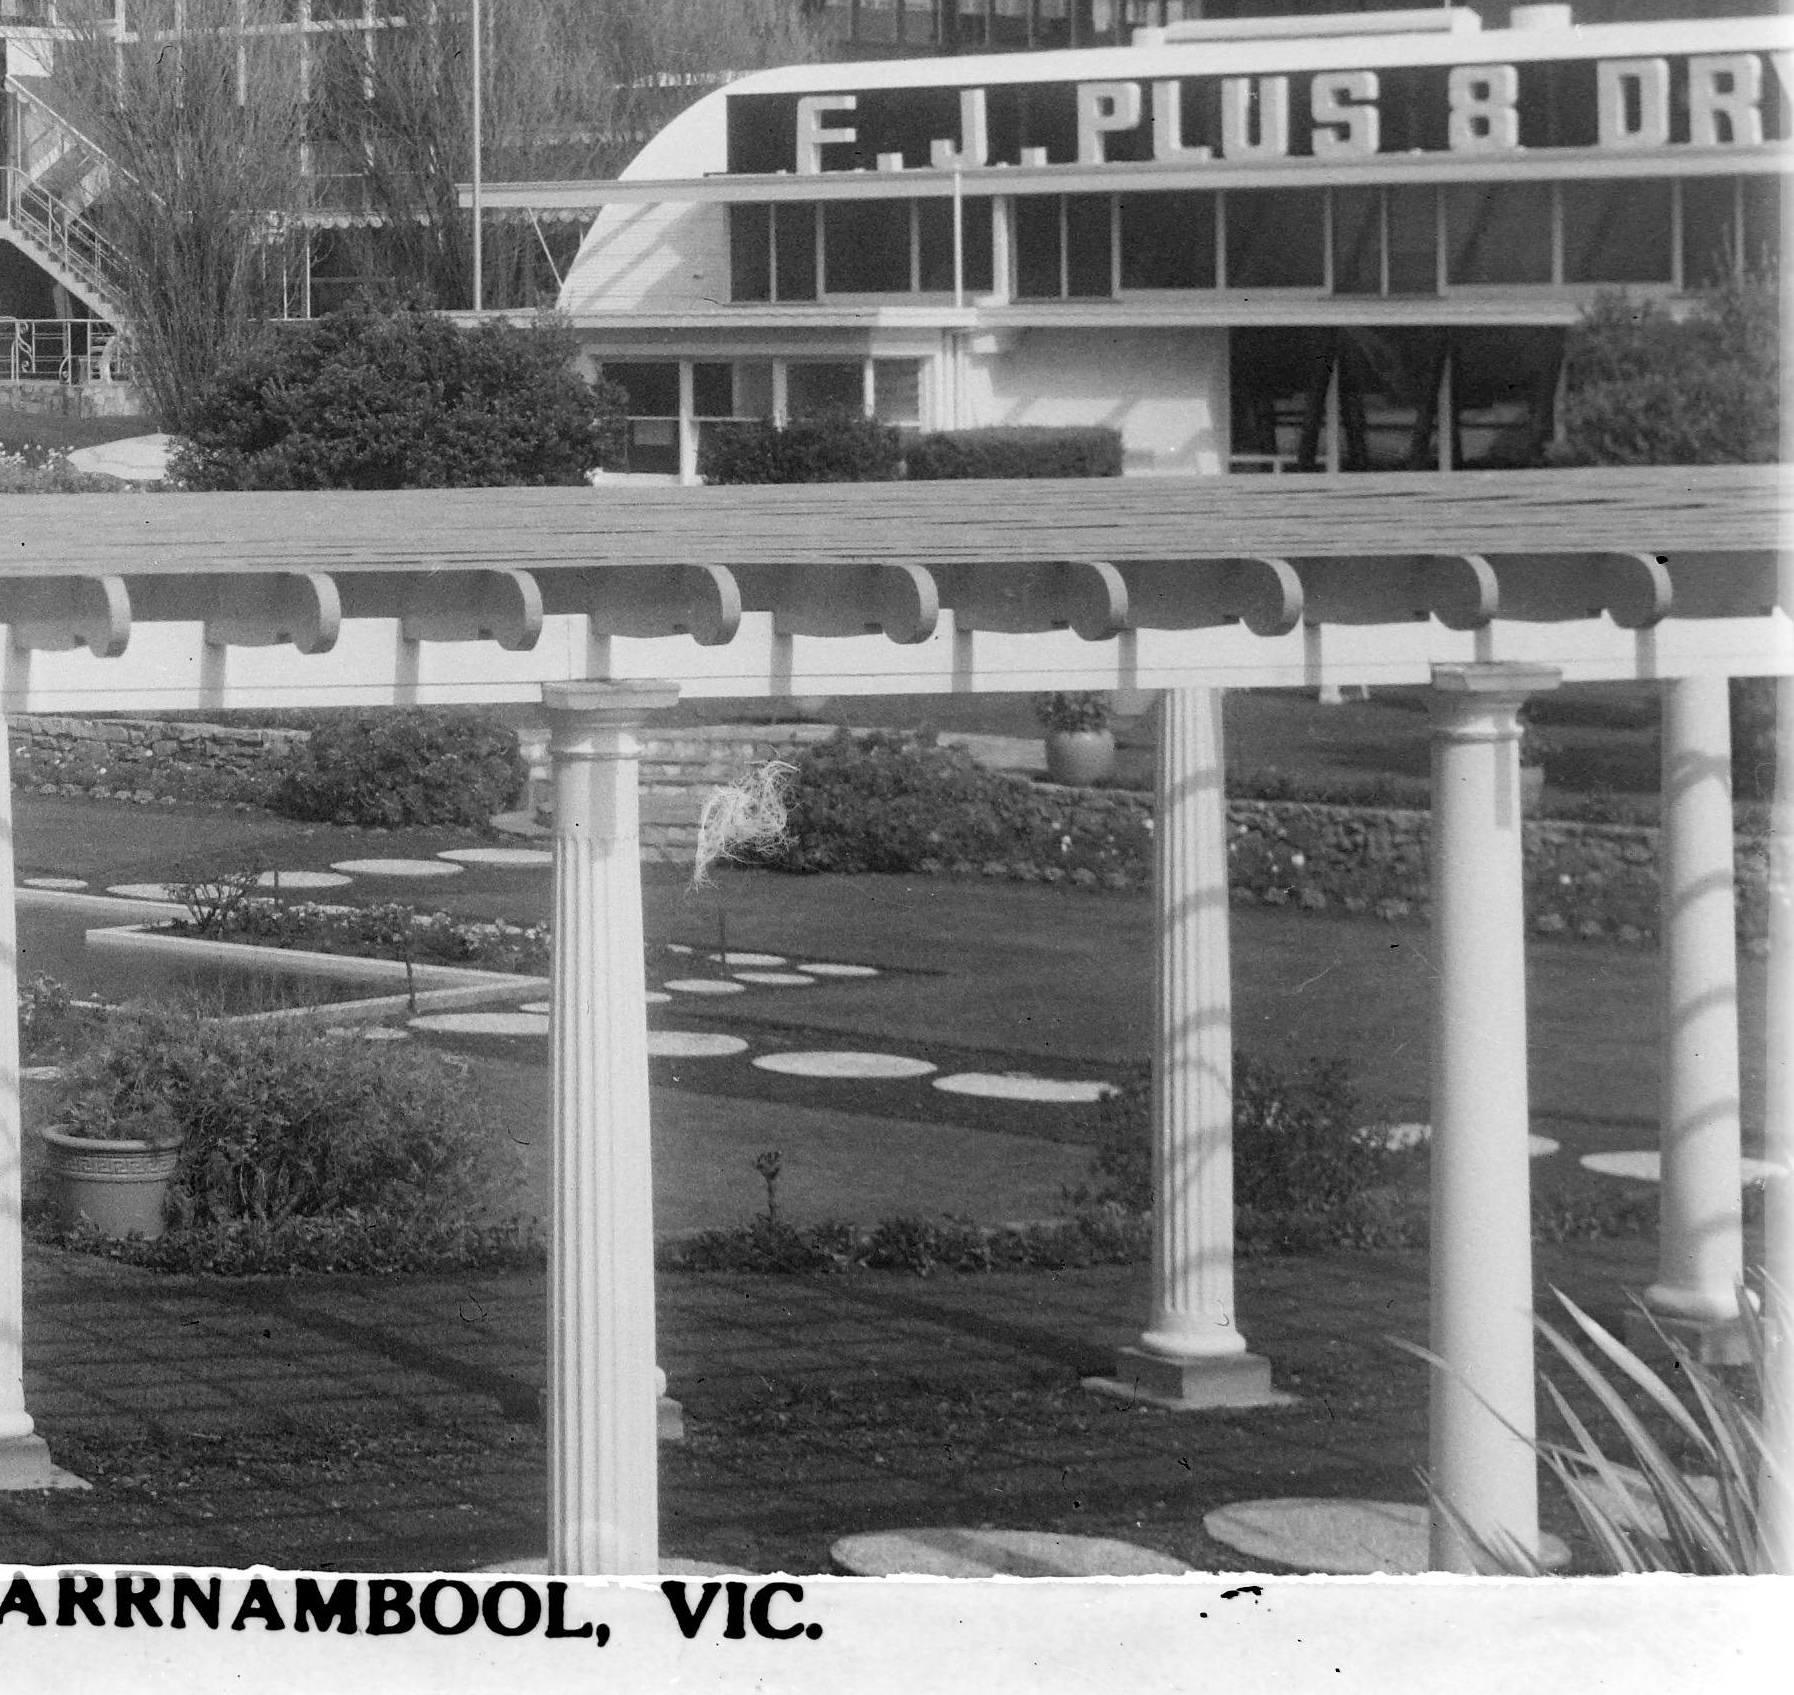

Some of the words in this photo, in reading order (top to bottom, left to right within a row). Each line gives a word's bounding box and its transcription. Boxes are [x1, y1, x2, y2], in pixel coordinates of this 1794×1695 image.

[796, 88, 1048, 175] F.J.
[1076, 70, 1380, 165] PLUS
[1447, 64, 1519, 154] 8
[1597, 52, 1794, 148] DR
